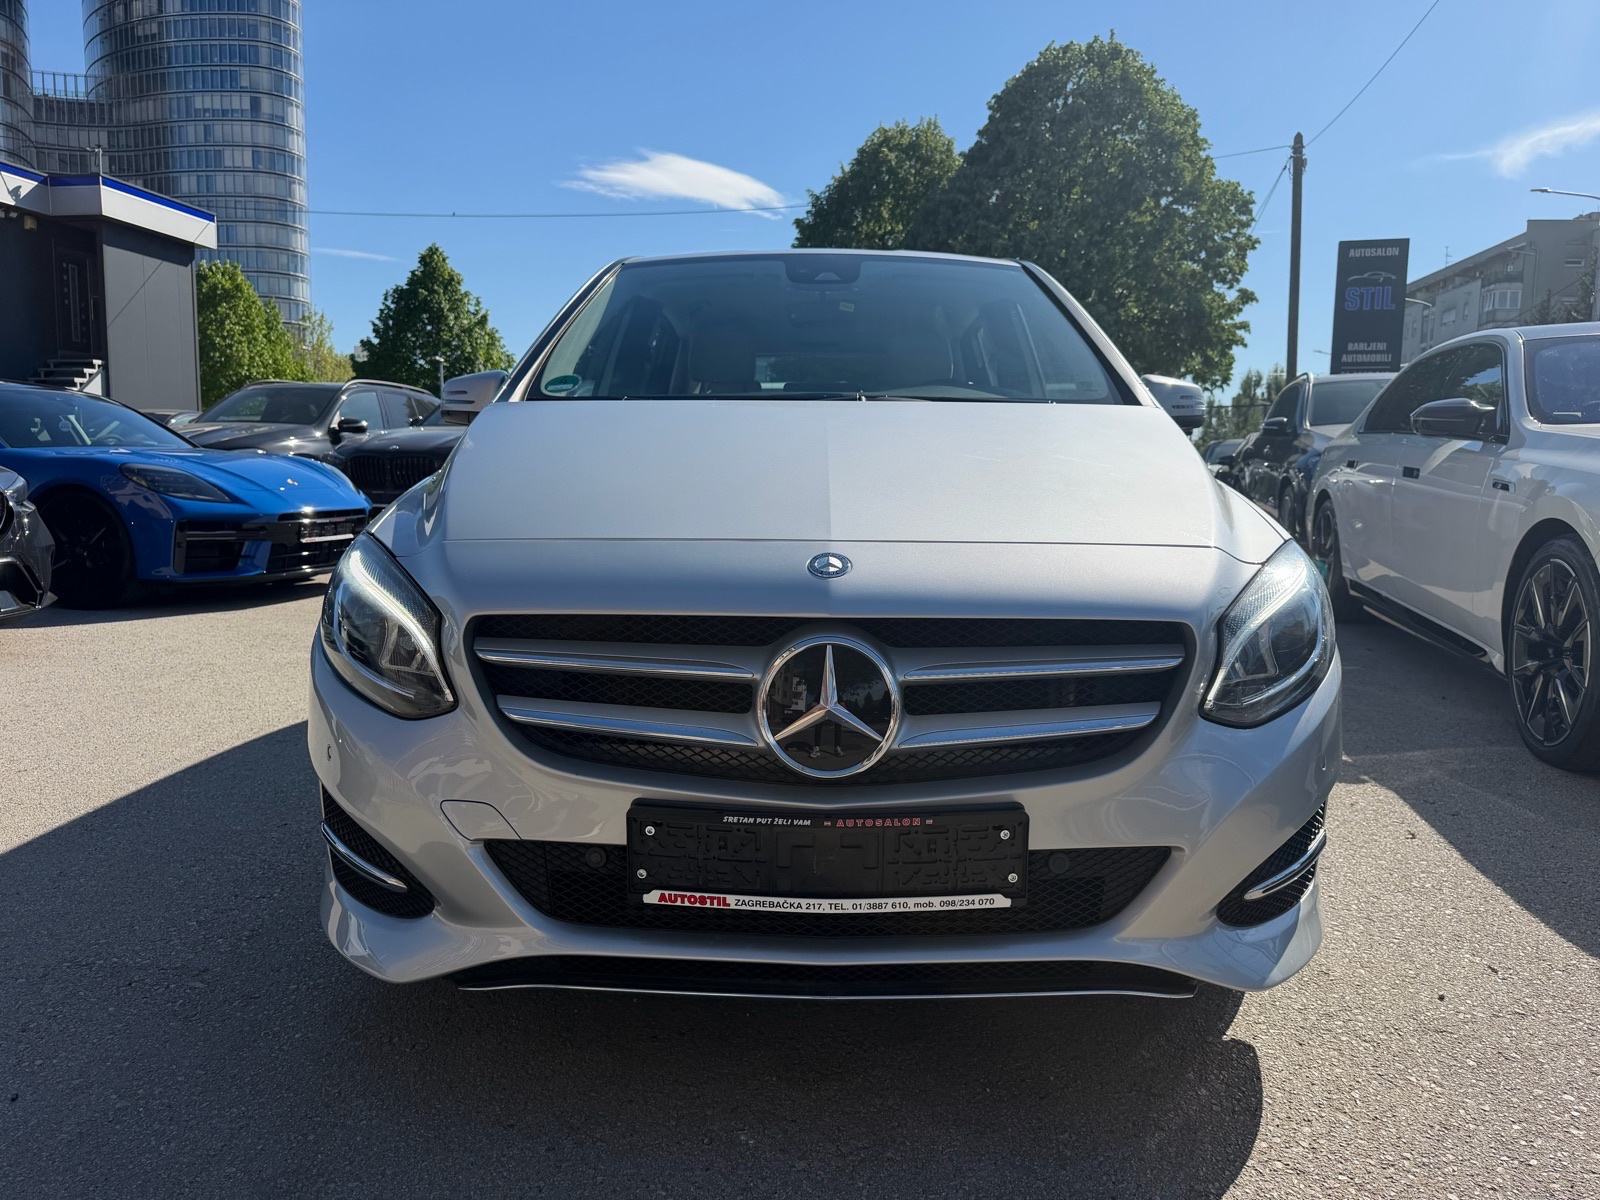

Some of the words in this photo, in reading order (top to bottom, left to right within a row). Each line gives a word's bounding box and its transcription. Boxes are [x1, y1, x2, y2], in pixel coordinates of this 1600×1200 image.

[1349, 247, 1399, 257] AUTOSALON
[1344, 286, 1396, 311] STIL
[1341, 353, 1392, 363] AUTOMOBILI
[723, 816, 754, 824] SRETAN
[836, 817, 921, 827] AUTOSALON
[658, 892, 731, 907] AUTOSTIL
[734, 898, 802, 910] ZAGREBAČKA
[805, 903, 825, 911] 217,
[828, 902, 849, 911] TEL.
[851, 902, 889, 911] 01/3887
[891, 901, 911, 910] 610,
[913, 901, 937, 909] mob.
[939, 899, 976, 908] 098/234
[978, 898, 995, 906] 070
